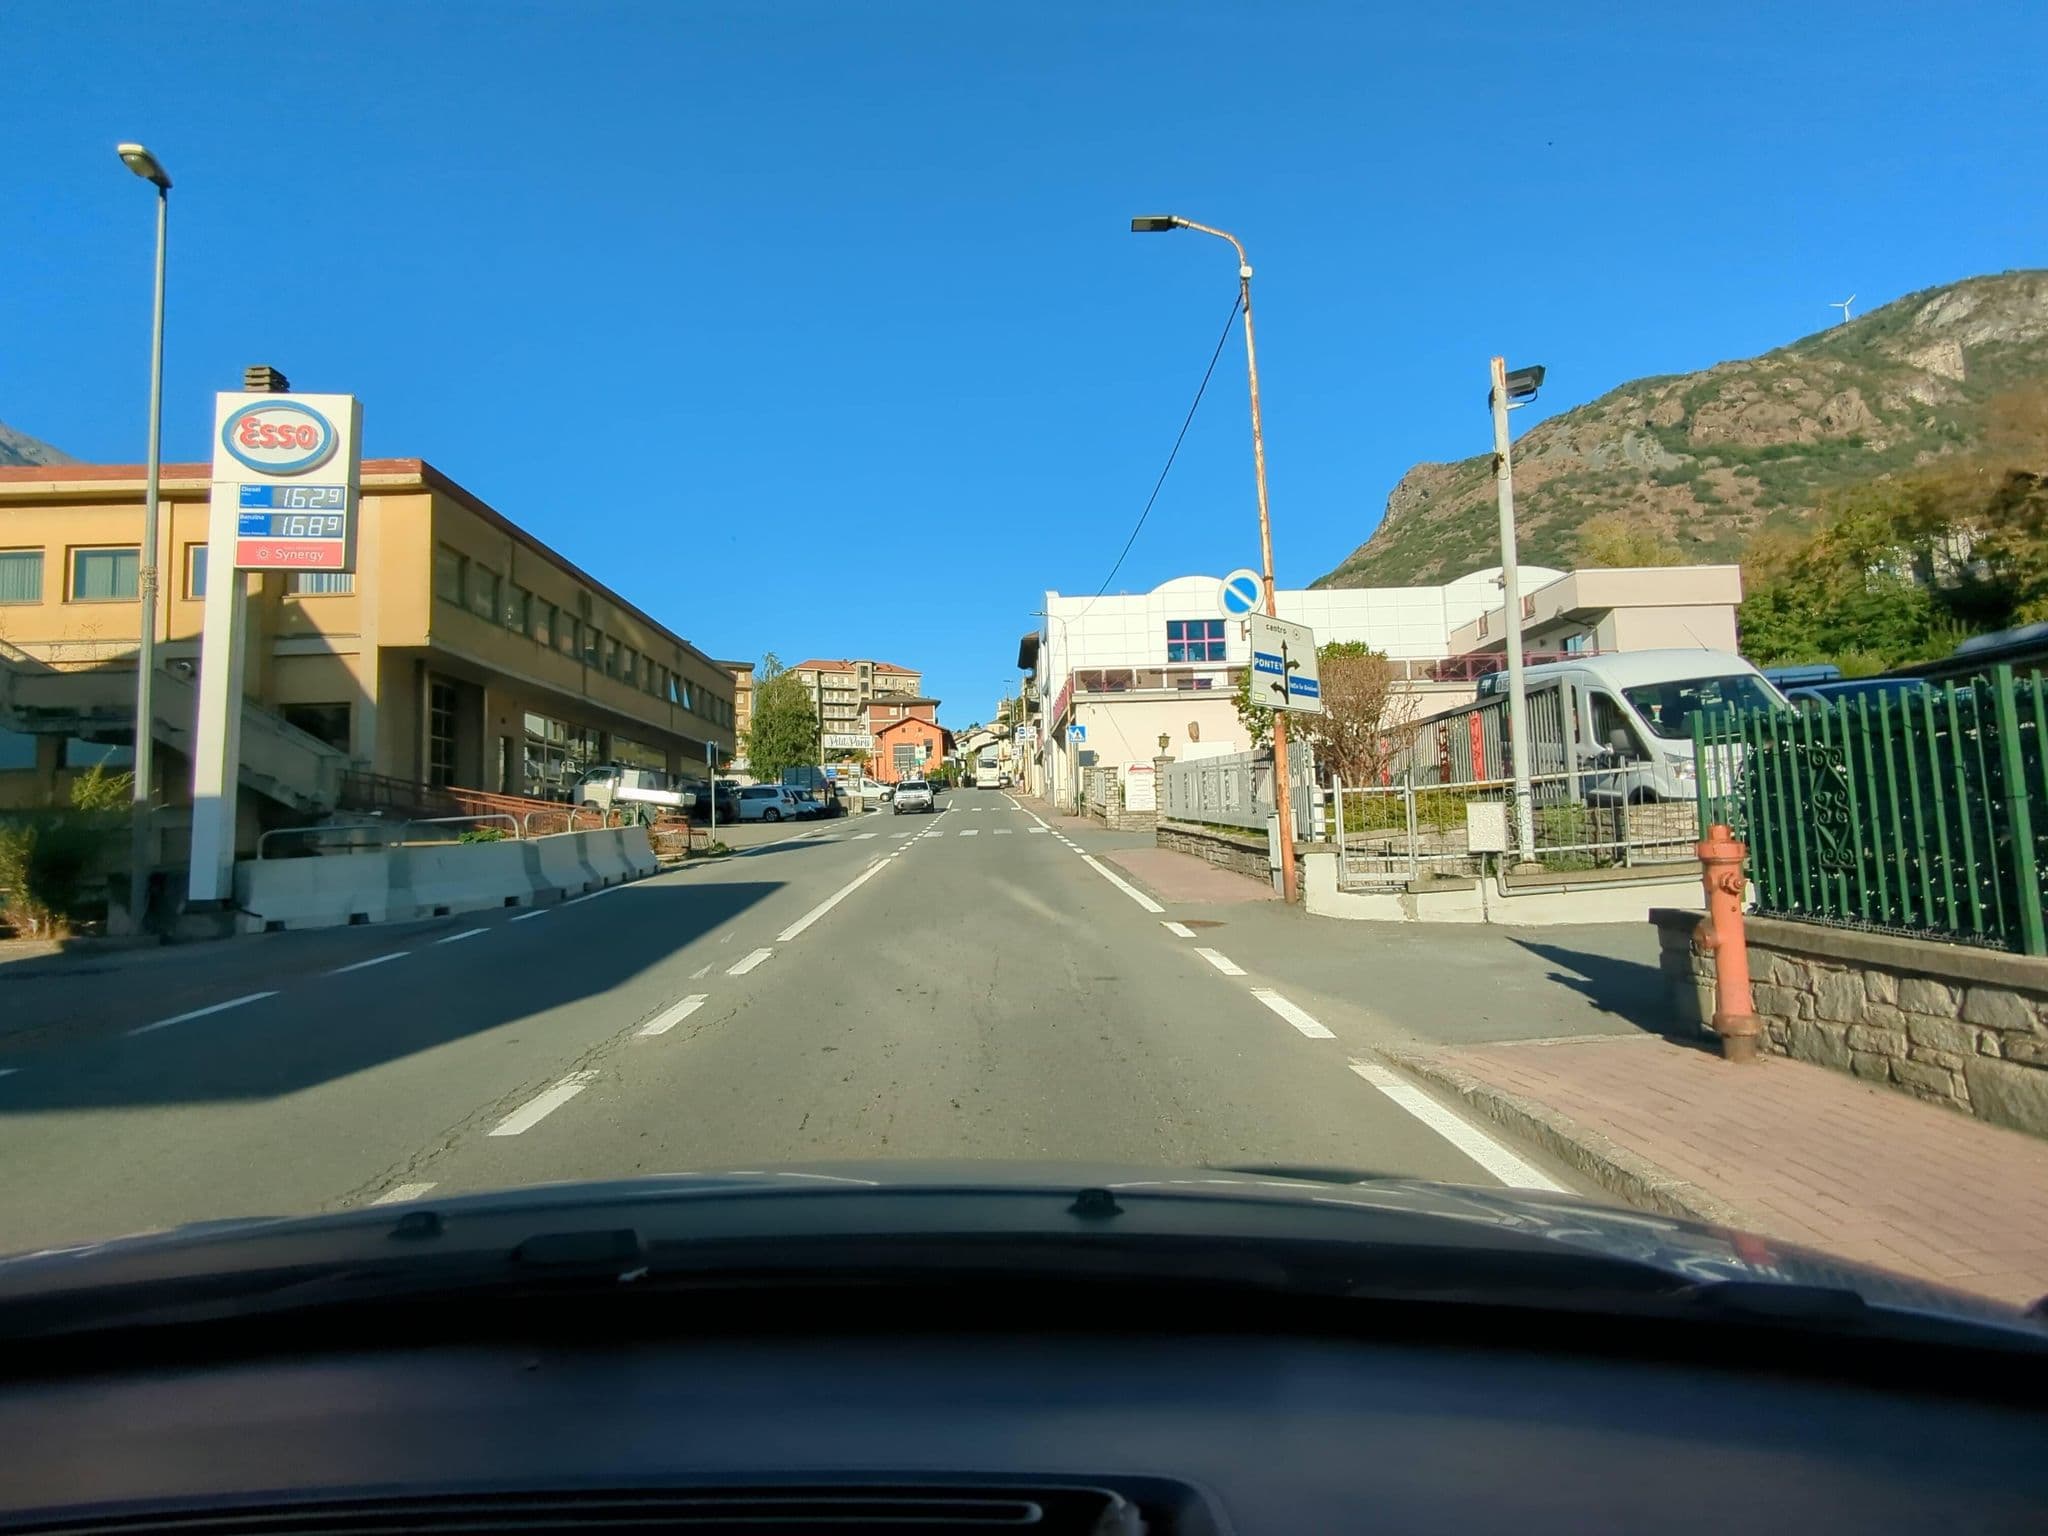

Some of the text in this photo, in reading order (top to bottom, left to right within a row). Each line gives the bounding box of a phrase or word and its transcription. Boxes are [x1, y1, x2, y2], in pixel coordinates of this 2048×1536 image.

[240, 416, 318, 449] Esso
[275, 548, 324, 561] Synergy
[1254, 658, 1283, 671] PONTEY
